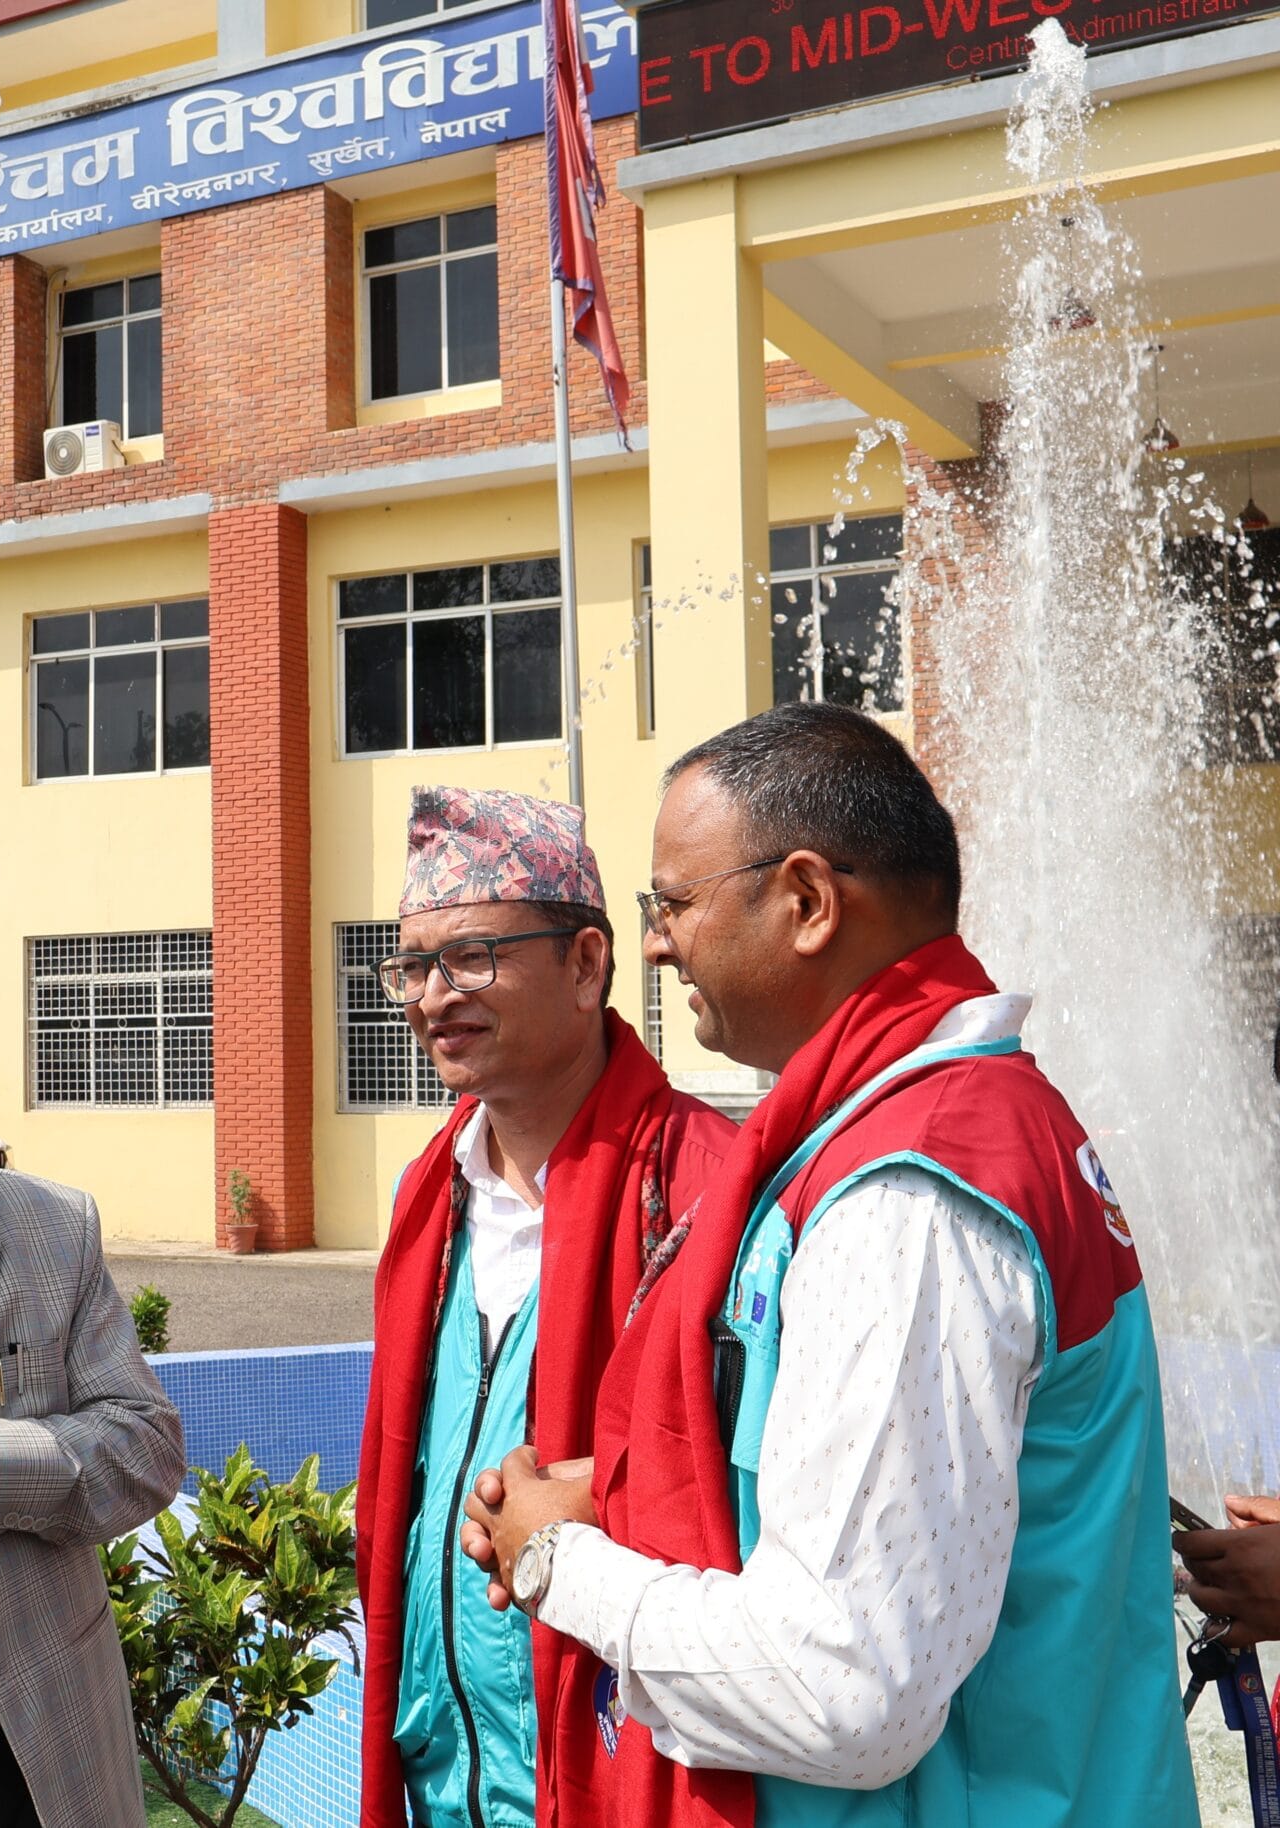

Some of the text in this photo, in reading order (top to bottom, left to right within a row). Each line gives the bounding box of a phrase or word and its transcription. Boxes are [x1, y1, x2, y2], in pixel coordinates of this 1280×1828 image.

[640, 0, 1102, 106] E TO MID-WE
[131, 161, 288, 212] वीरेन्द्रनगर,
[307, 136, 395, 175] सुर्खेत,
[419, 107, 511, 145] नेपाल
[1262, 1728, 1272, 1740] THE
